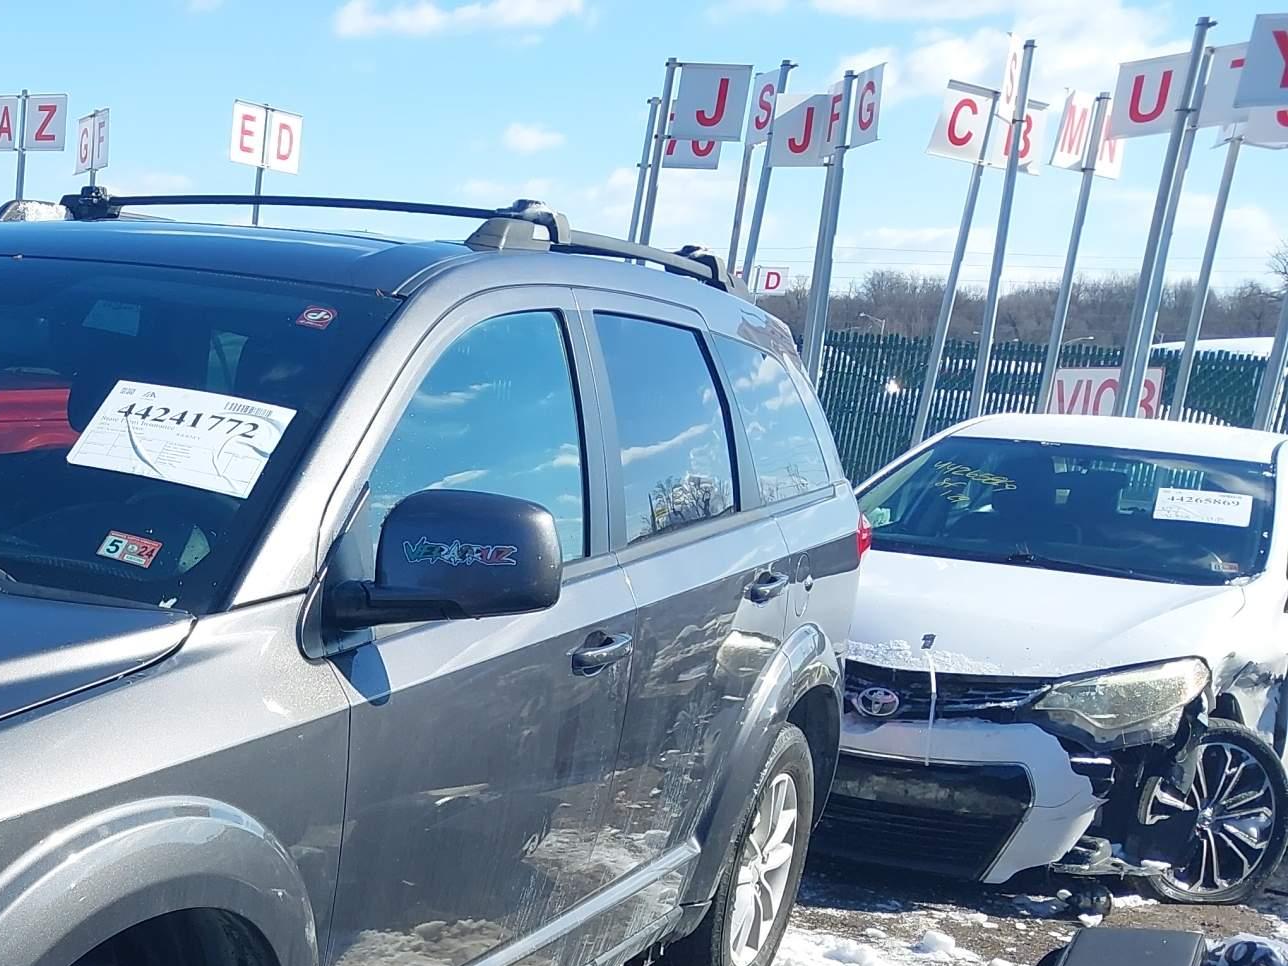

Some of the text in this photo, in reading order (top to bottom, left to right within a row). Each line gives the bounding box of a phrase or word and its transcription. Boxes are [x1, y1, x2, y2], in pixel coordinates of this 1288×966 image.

[696, 78, 729, 126] J
[755, 83, 775, 130] S
[858, 81, 876, 131] G
[1129, 70, 1173, 123] U
[34, 105, 58, 141] Z
[96, 121, 106, 159] F
[239, 114, 257, 153] E
[788, 107, 815, 154] J
[947, 98, 979, 146] C
[1060, 104, 1088, 155] M
[79, 127, 90, 164] G
[276, 123, 294, 161] D
[765, 271, 781, 290] D
[117, 402, 261, 439] 44241772
[106, 539, 123, 554] 5
[138, 545, 155, 559] 24
